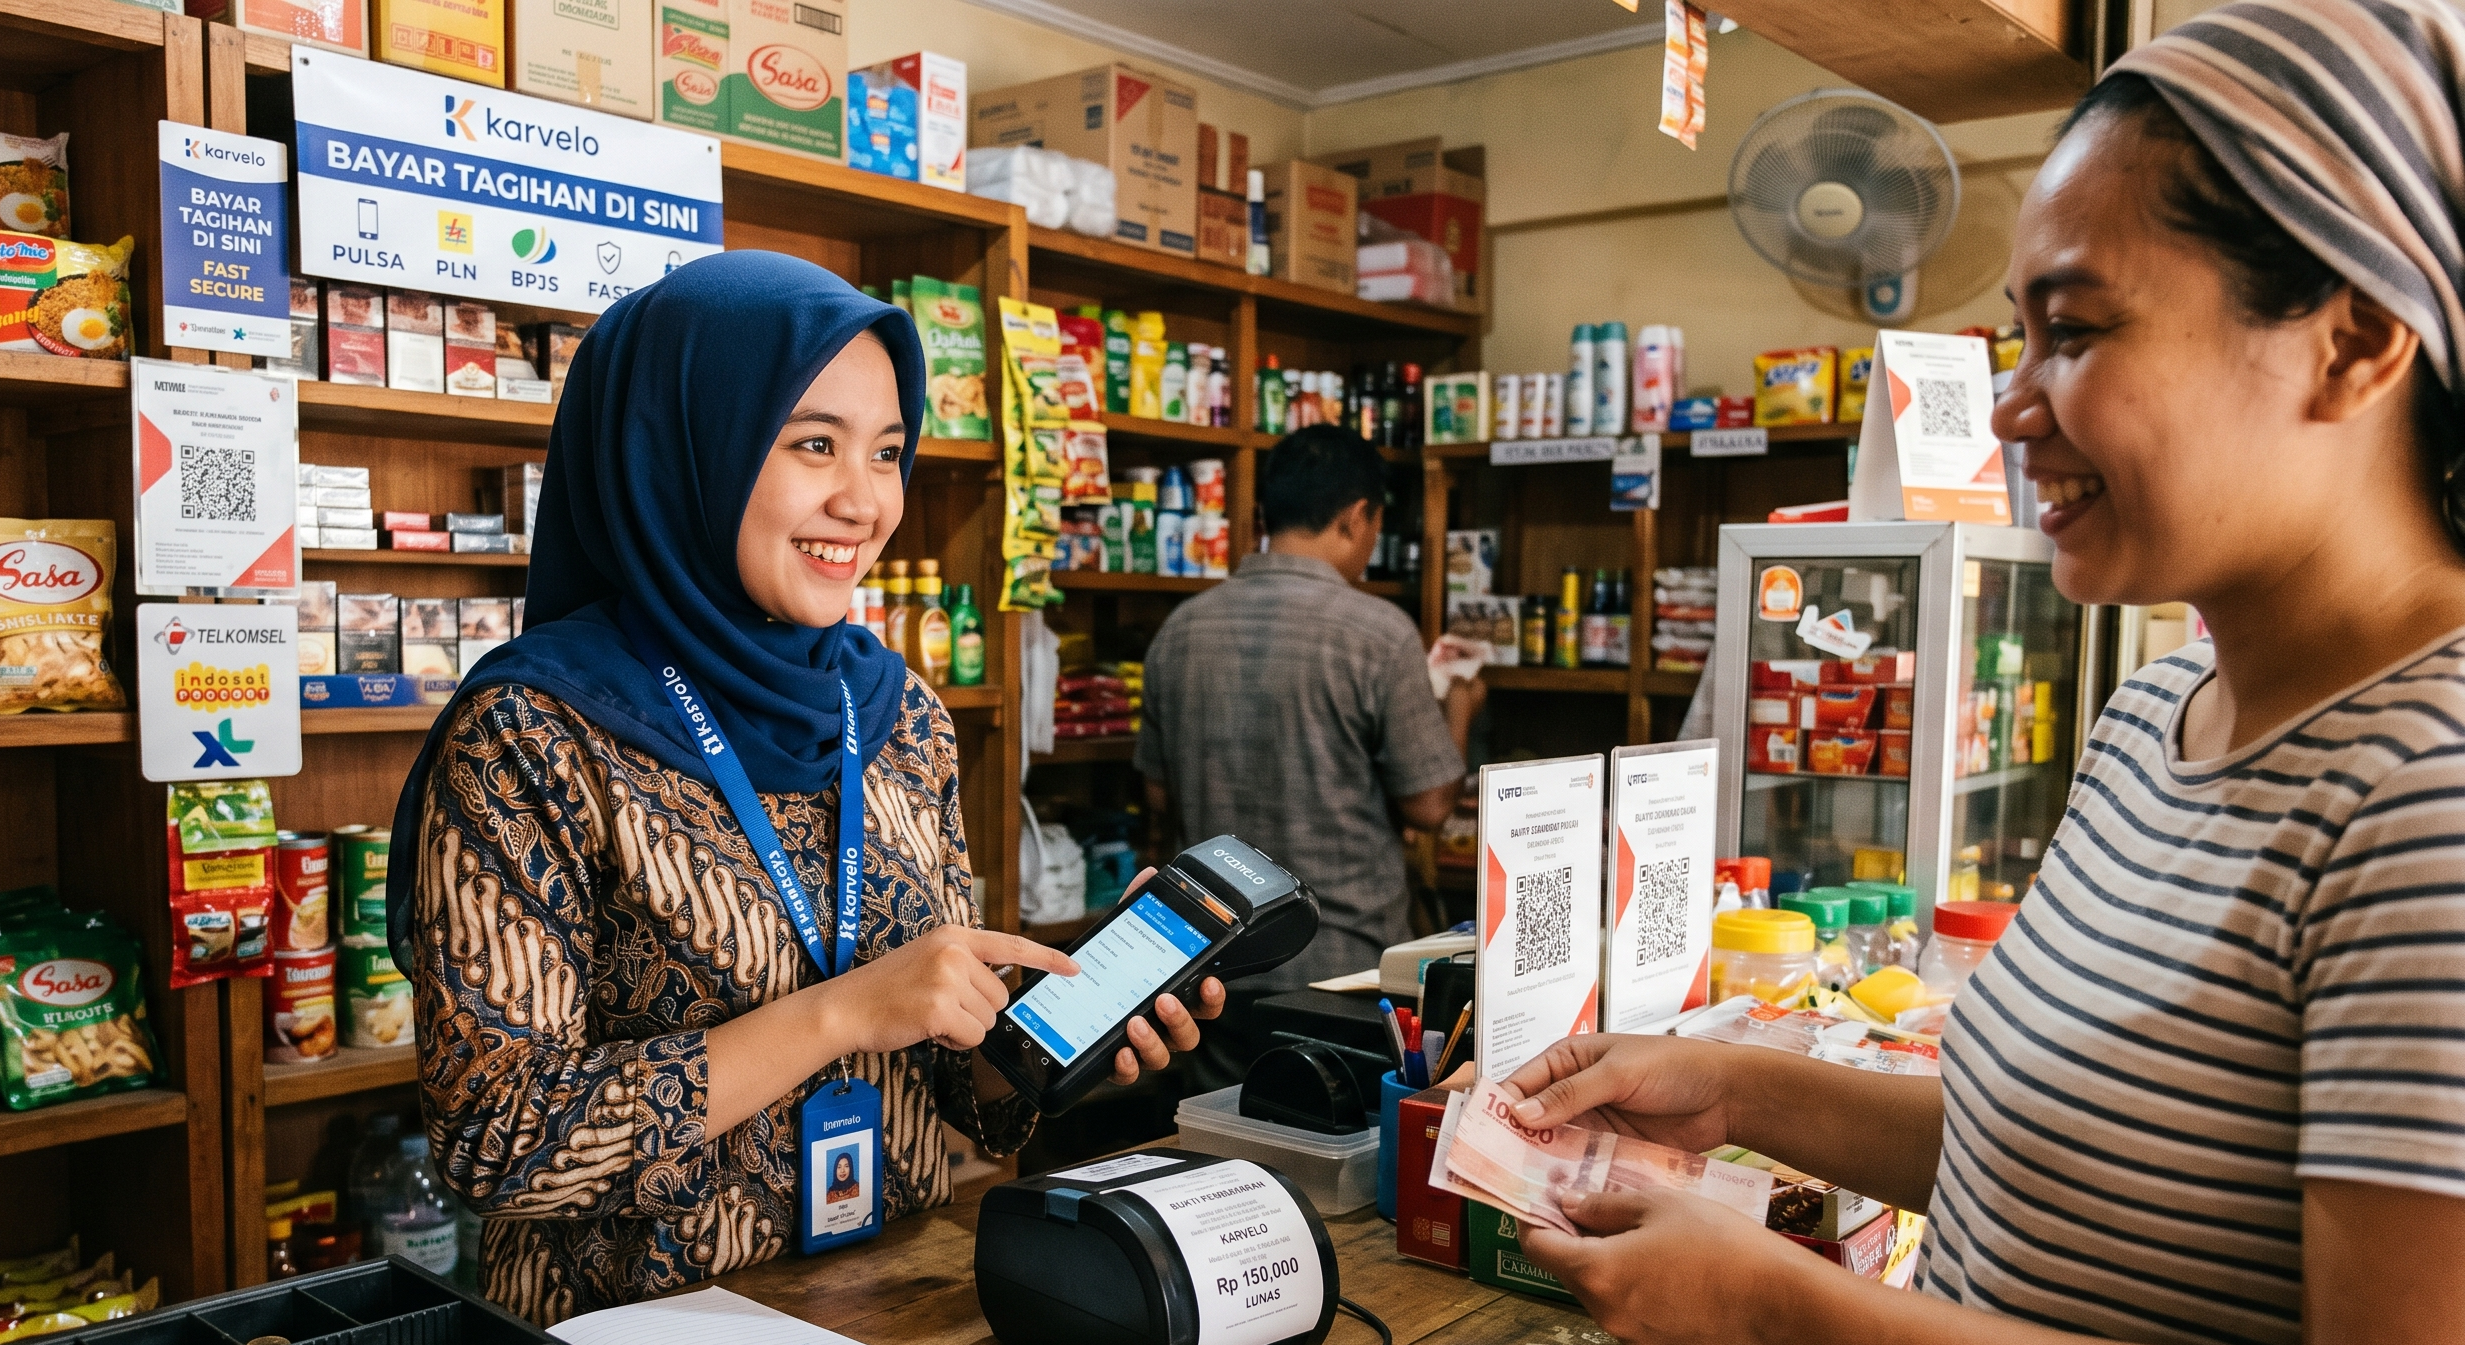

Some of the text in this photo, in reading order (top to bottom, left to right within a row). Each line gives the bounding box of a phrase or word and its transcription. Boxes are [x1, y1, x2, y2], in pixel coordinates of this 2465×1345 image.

[761, 51, 820, 93] Sasa
[486, 107, 600, 157] karvelo
[205, 143, 266, 167] karvelo
[327, 140, 699, 234] BAYAR TAGIHAN DI SINI
[191, 187, 262, 215] BAYAR
[179, 207, 273, 237] TAGIHAN
[193, 230, 262, 255] DI SINI
[203, 260, 250, 281] FAST
[332, 244, 405, 271] PULSA
[436, 259, 477, 281] PLN
[190, 279, 265, 302] SECURE
[511, 270, 559, 293] BPJS
[588, 281, 634, 300] FAST
[0, 549, 85, 591] Sasa
[198, 629, 287, 644] TELKOMSEL
[181, 673, 265, 687] indosat
[192, 717, 255, 768] XL
[842, 847, 858, 917] karvelo
[33, 965, 104, 997] Sasa
[1219, 1223, 1268, 1245] KARVELO
[1216, 1257, 1299, 1296] Rp 150,000
[1246, 1288, 1281, 1309] LUNAS
